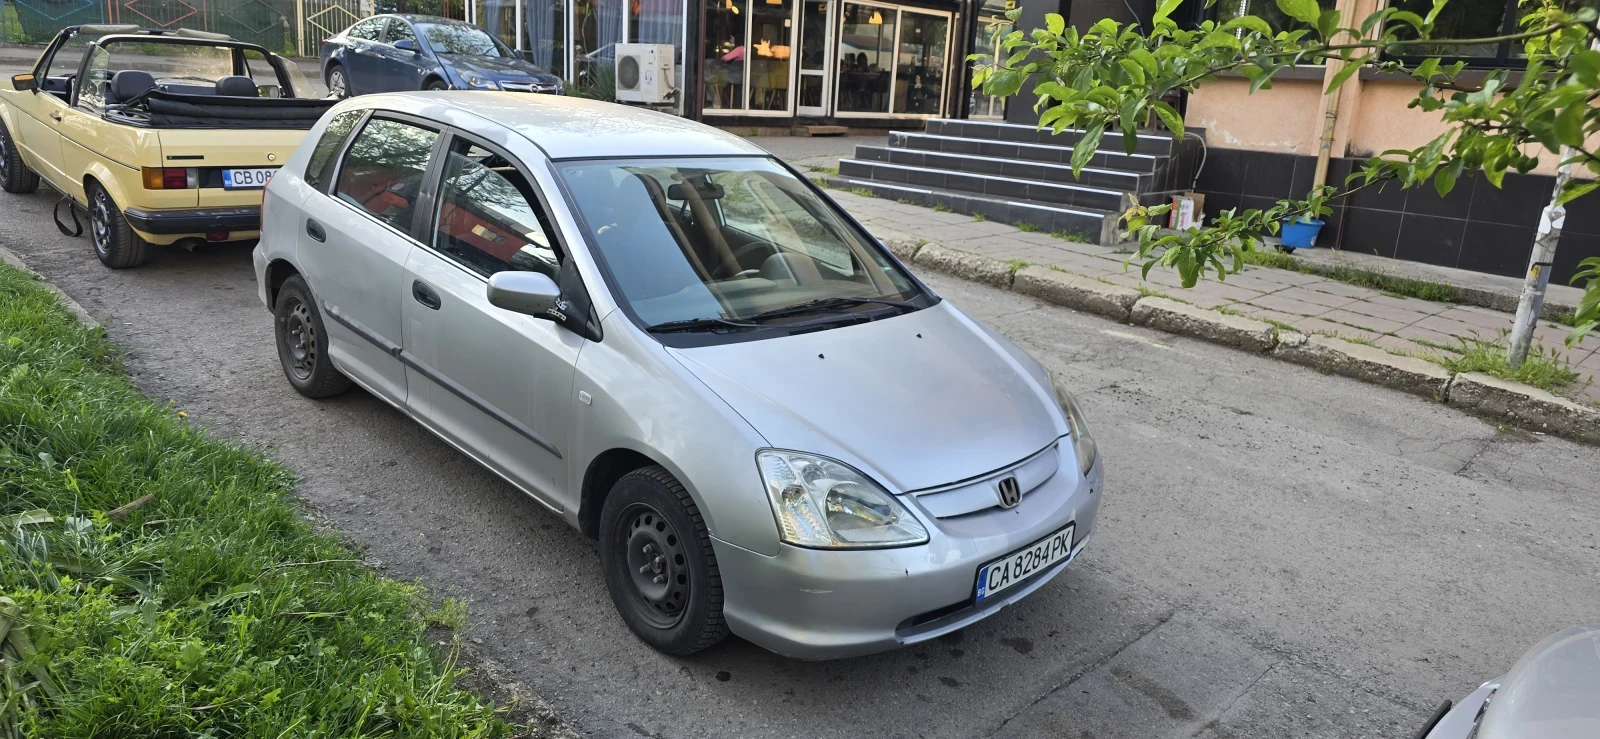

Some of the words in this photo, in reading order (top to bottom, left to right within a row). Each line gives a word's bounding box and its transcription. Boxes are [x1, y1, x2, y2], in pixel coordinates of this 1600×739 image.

[233, 171, 253, 184] CB
[256, 170, 277, 184] 08
[988, 562, 1009, 591] CA
[1013, 541, 1051, 579] 8284
[1051, 530, 1071, 560] PK
[977, 587, 985, 597] BG
